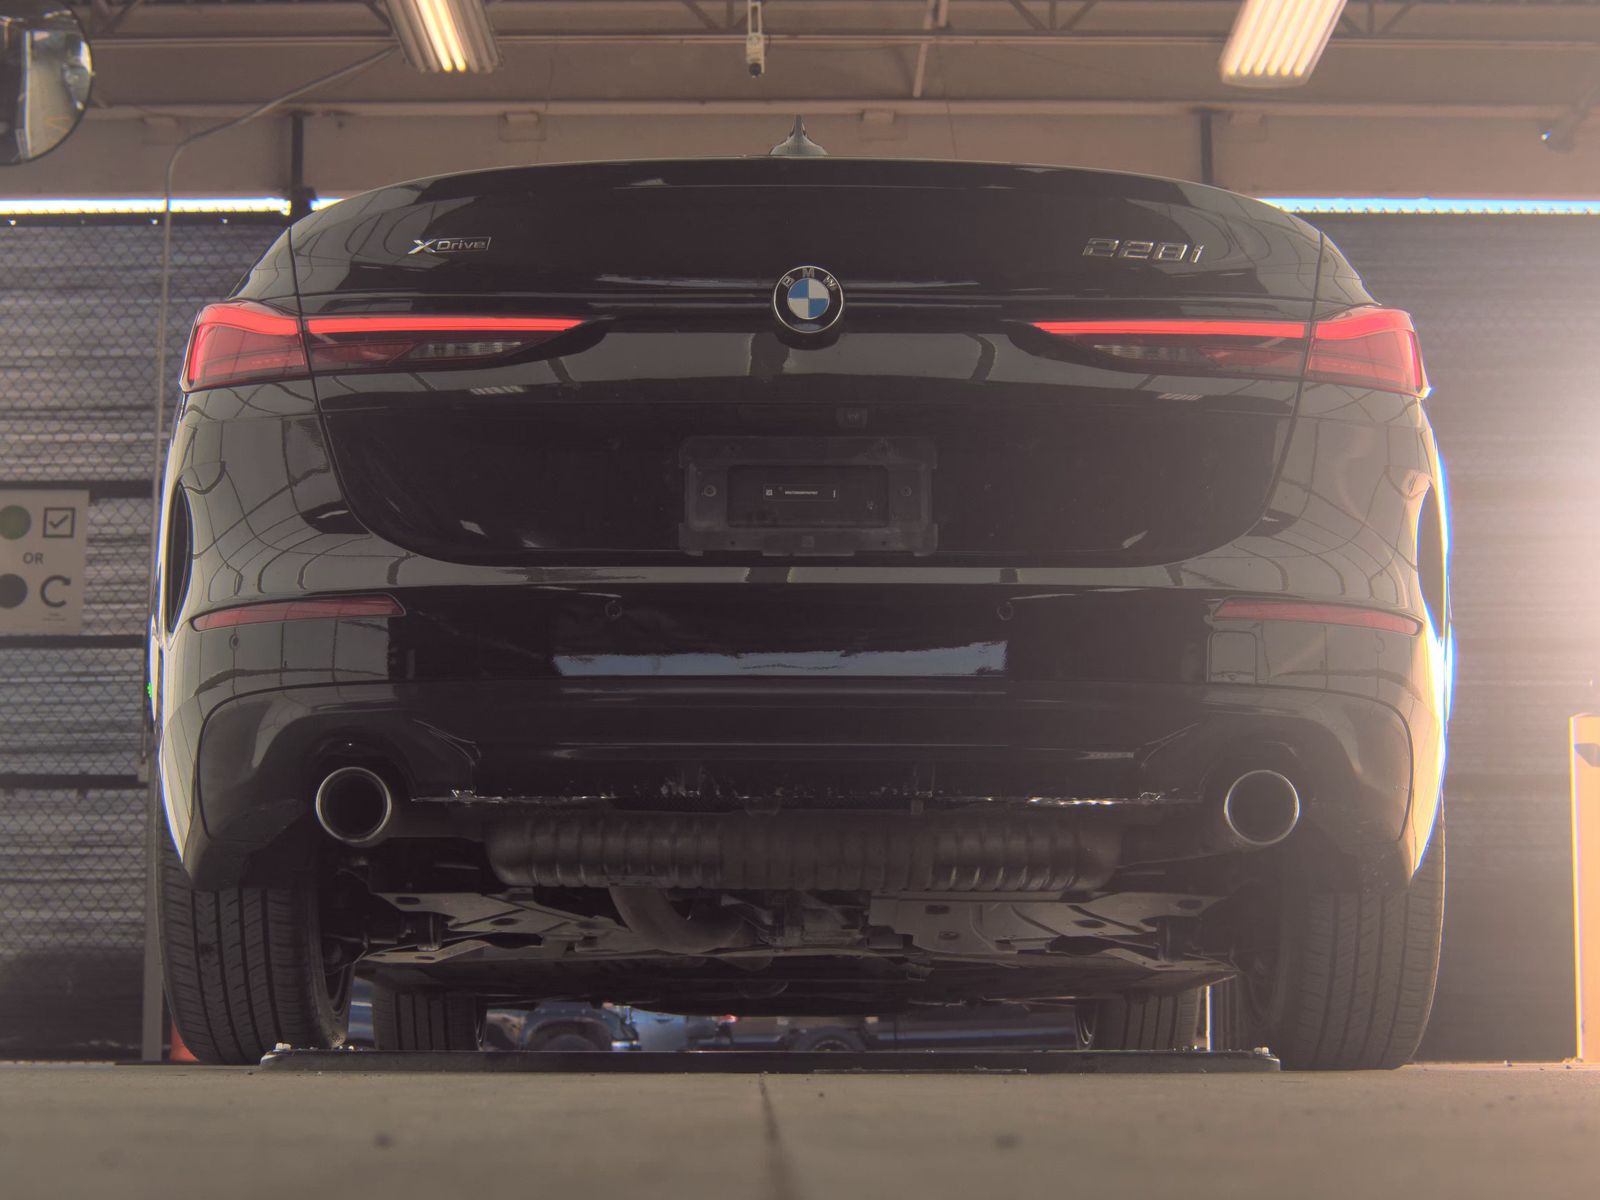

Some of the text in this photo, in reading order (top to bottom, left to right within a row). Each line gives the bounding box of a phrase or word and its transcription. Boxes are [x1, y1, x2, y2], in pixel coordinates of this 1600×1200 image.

[1083, 238, 1204, 263] 228i
[781, 268, 837, 291] BMW
[23, 552, 44, 565] OR
